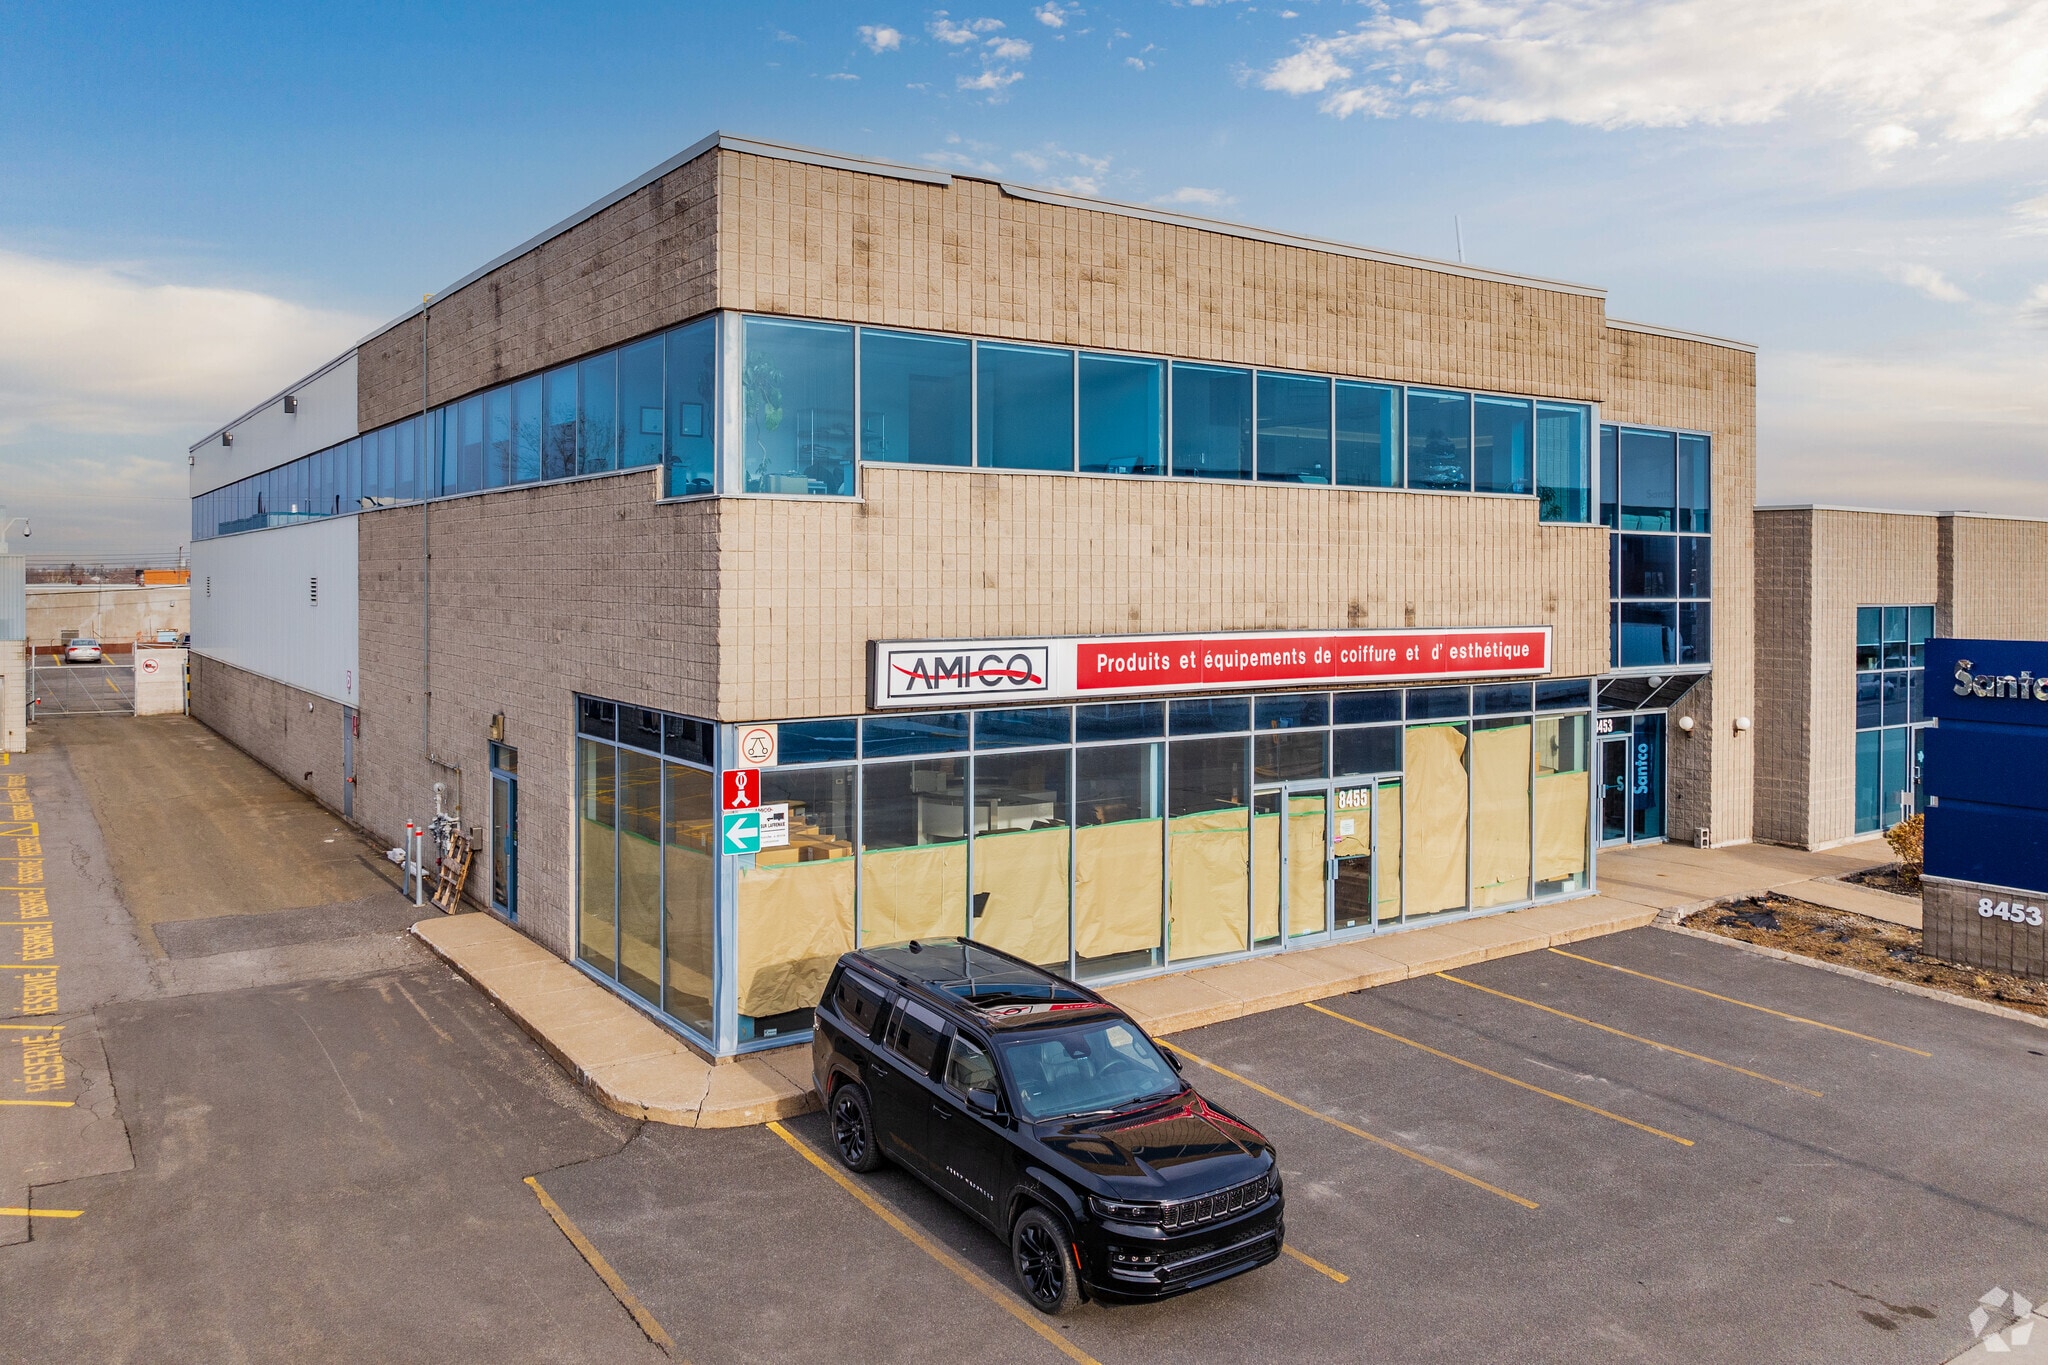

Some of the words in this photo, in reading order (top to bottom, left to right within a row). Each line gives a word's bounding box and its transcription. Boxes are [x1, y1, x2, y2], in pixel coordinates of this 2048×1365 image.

[906, 653, 1033, 691] AMICO
[1097, 652, 1170, 673] Produits
[1179, 651, 1197, 669] et
[1204, 647, 1306, 672] équipements
[1314, 647, 1331, 664] de
[1340, 644, 1397, 664] coiffure
[1406, 645, 1420, 661] et
[1450, 641, 1530, 662] esthétique
[1633, 743, 1649, 794] Santco
[1339, 789, 1367, 808] 8455
[1978, 898, 2043, 926] 8453
